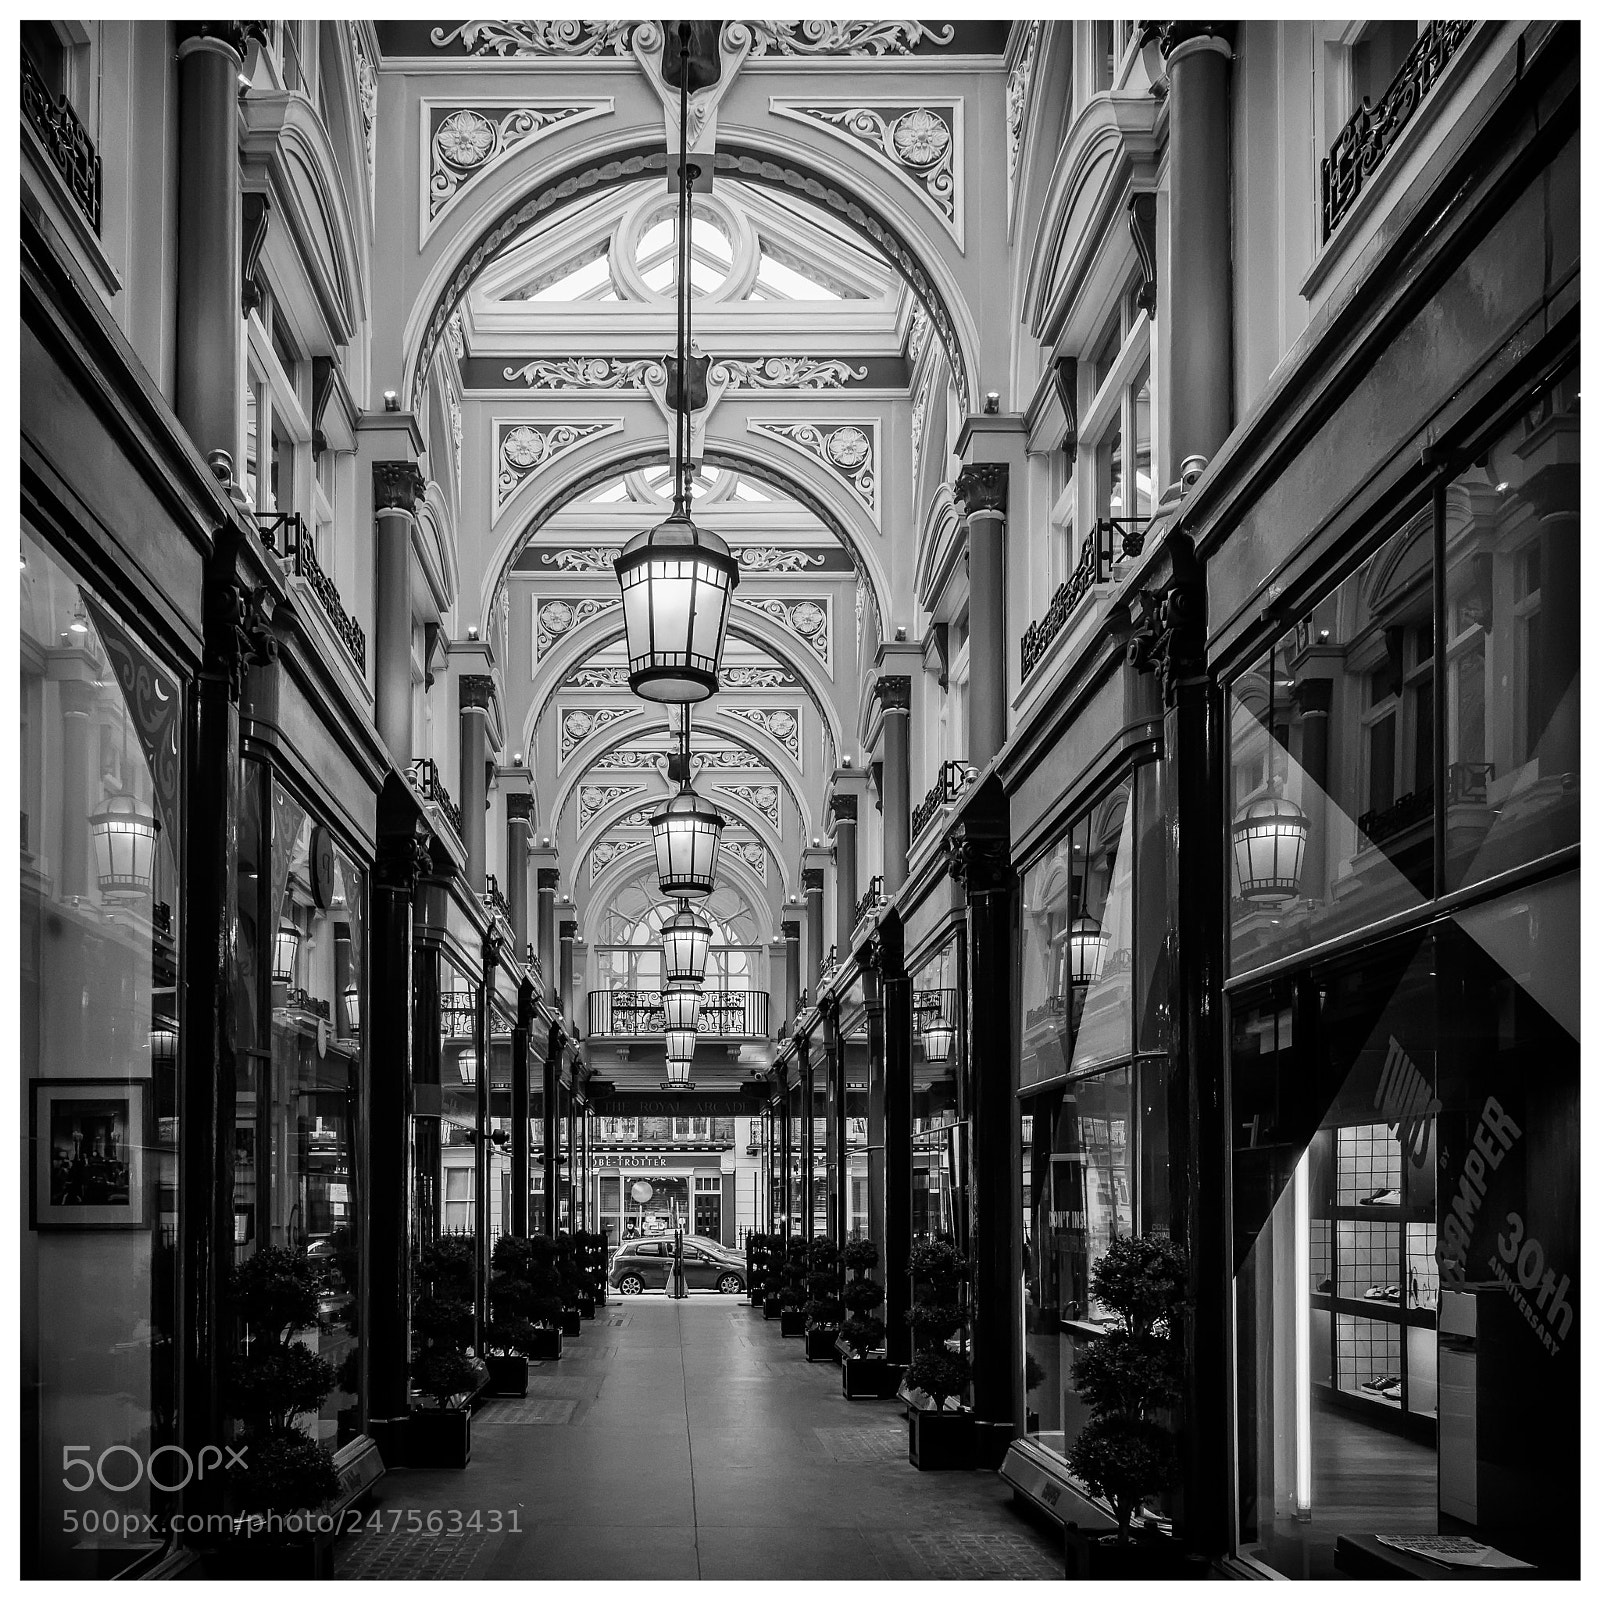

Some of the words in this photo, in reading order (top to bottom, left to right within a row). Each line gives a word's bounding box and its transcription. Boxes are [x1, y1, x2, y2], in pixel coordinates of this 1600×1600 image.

[604, 1101, 631, 1113] THE
[640, 1101, 683, 1113] ROYAL
[696, 1101, 750, 1113] ARCADE
[1439, 1144, 1450, 1170] BY
[1436, 1095, 1524, 1294] CAMPER
[1487, 1255, 1561, 1357] ANNIVERSARY
[1497, 1211, 1574, 1341] 30th
